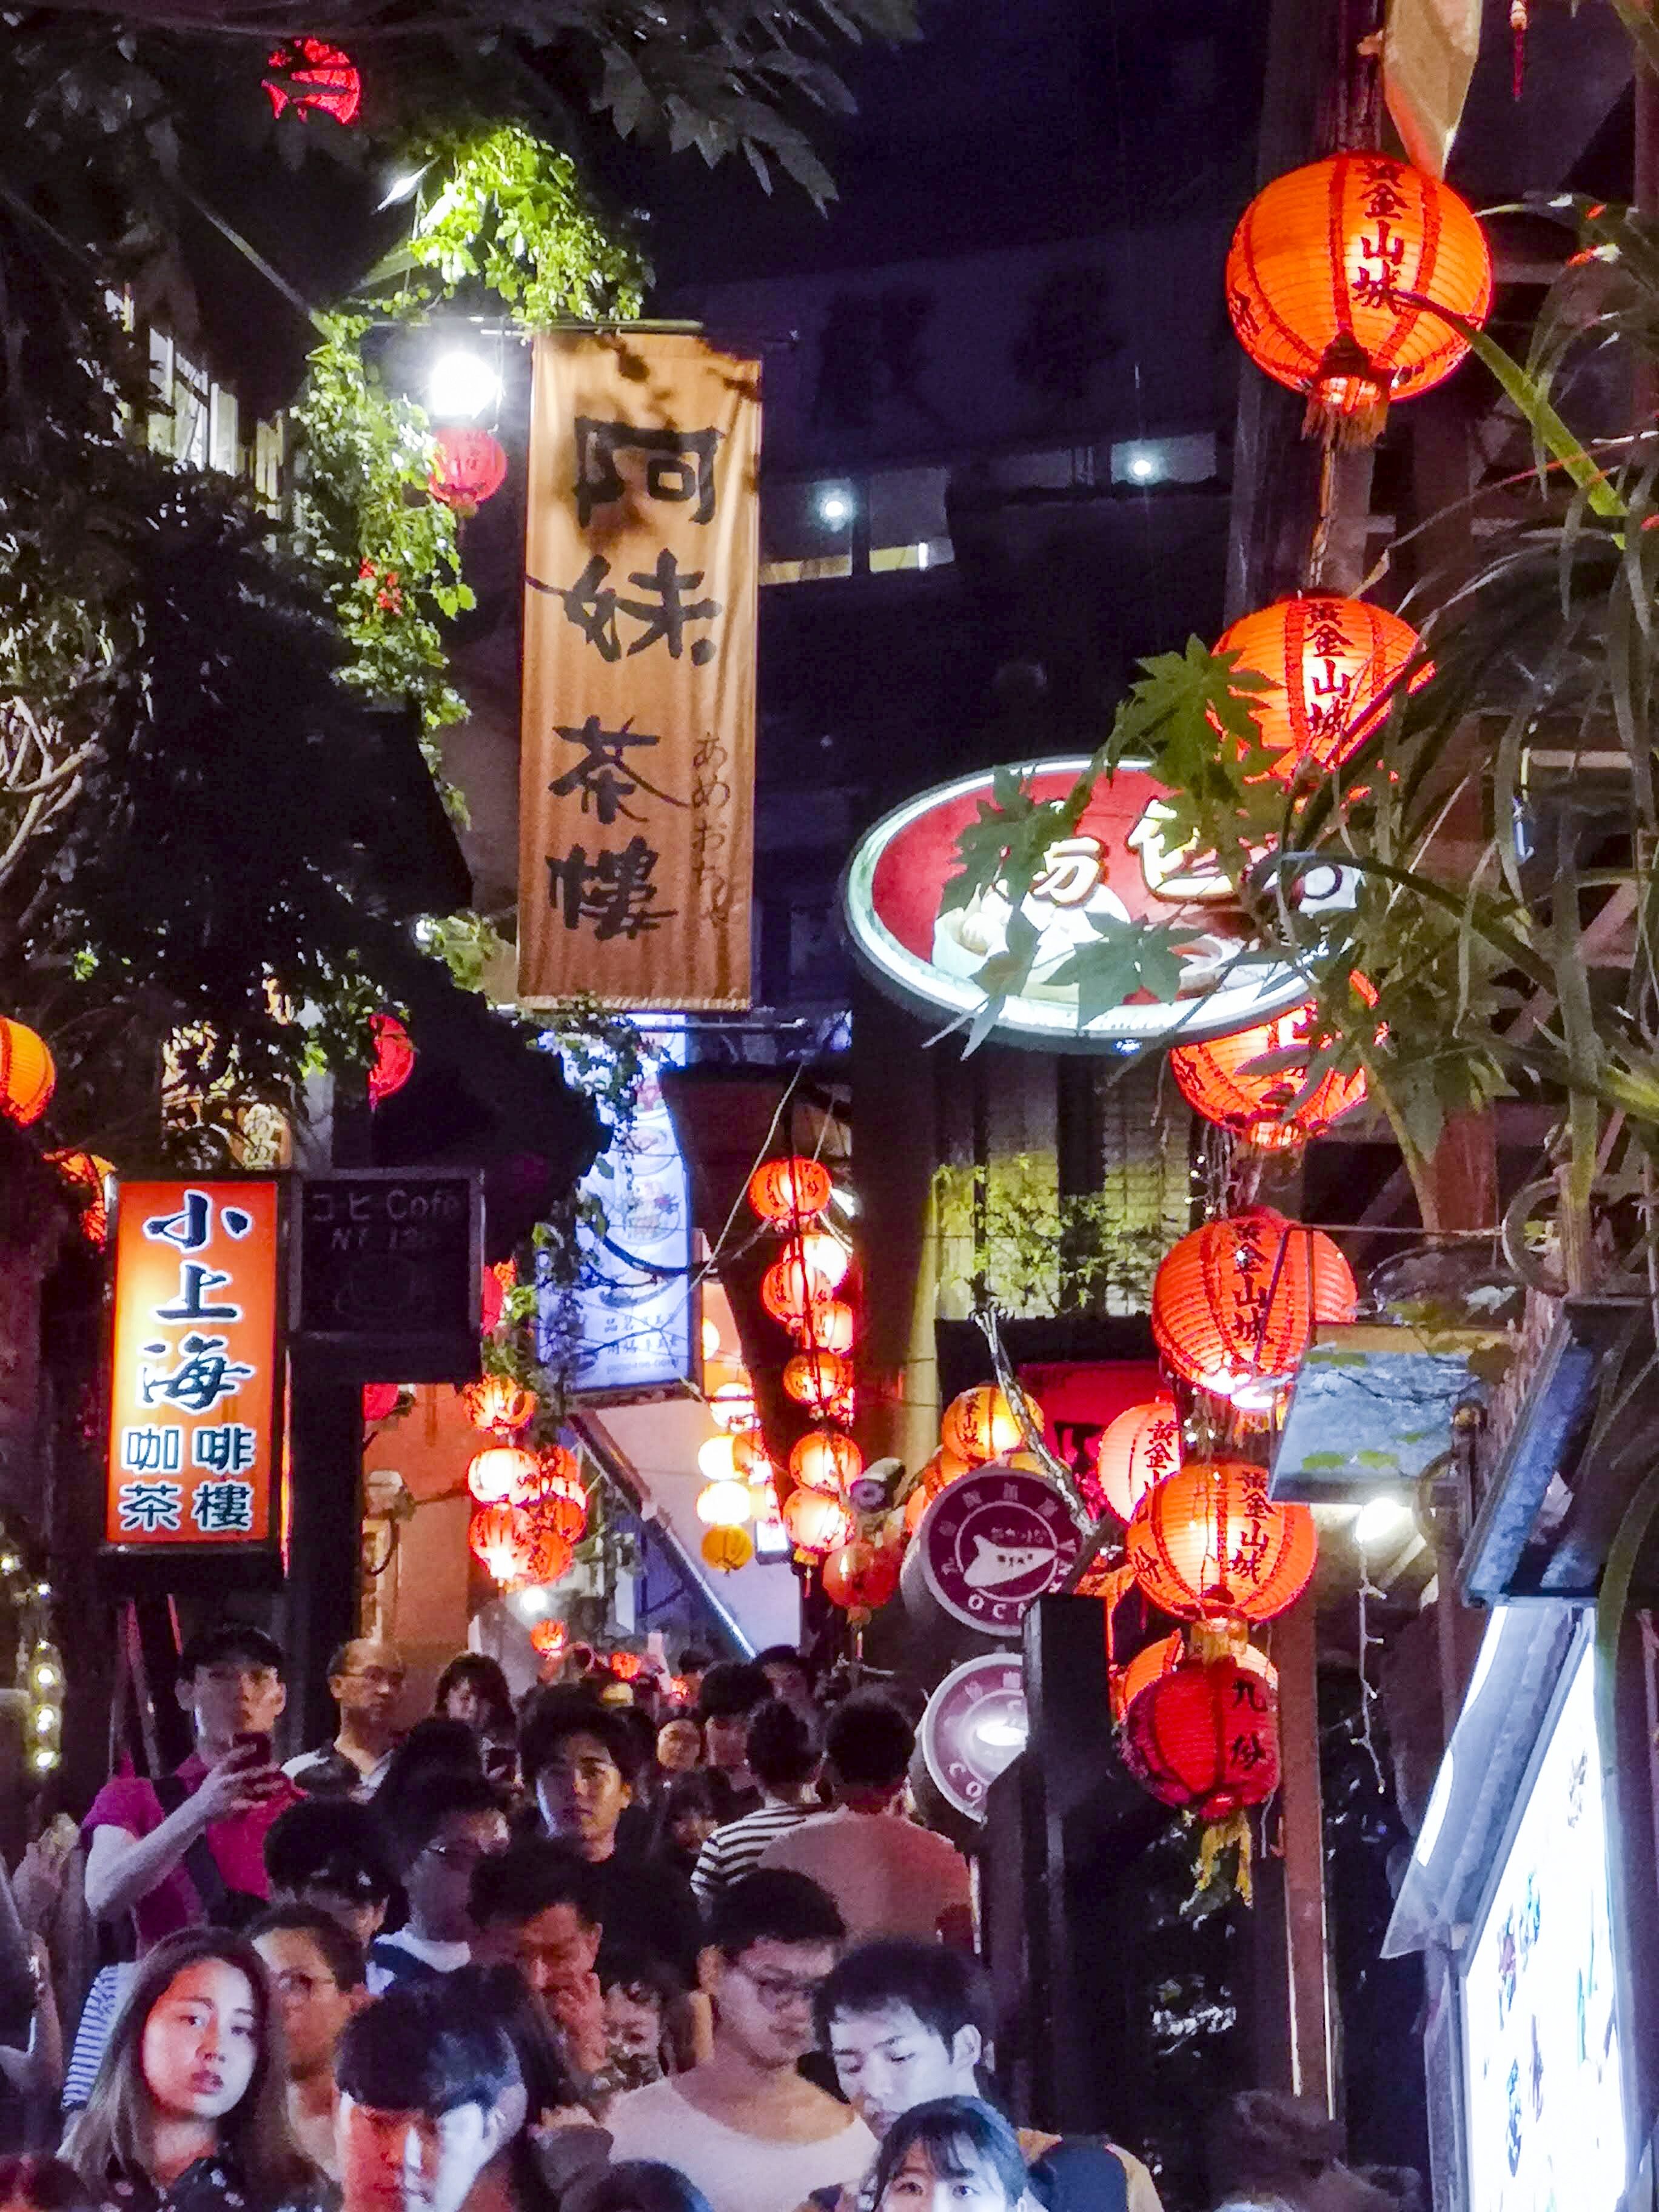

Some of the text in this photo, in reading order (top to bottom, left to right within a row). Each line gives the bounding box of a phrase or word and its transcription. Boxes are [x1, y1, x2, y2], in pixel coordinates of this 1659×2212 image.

[546, 415, 724, 940] 阿妹茶樓
[137, 1189, 255, 1414] 小上海
[119, 1481, 253, 1532] 茶樓
[121, 1424, 255, 1475] 咖啡
